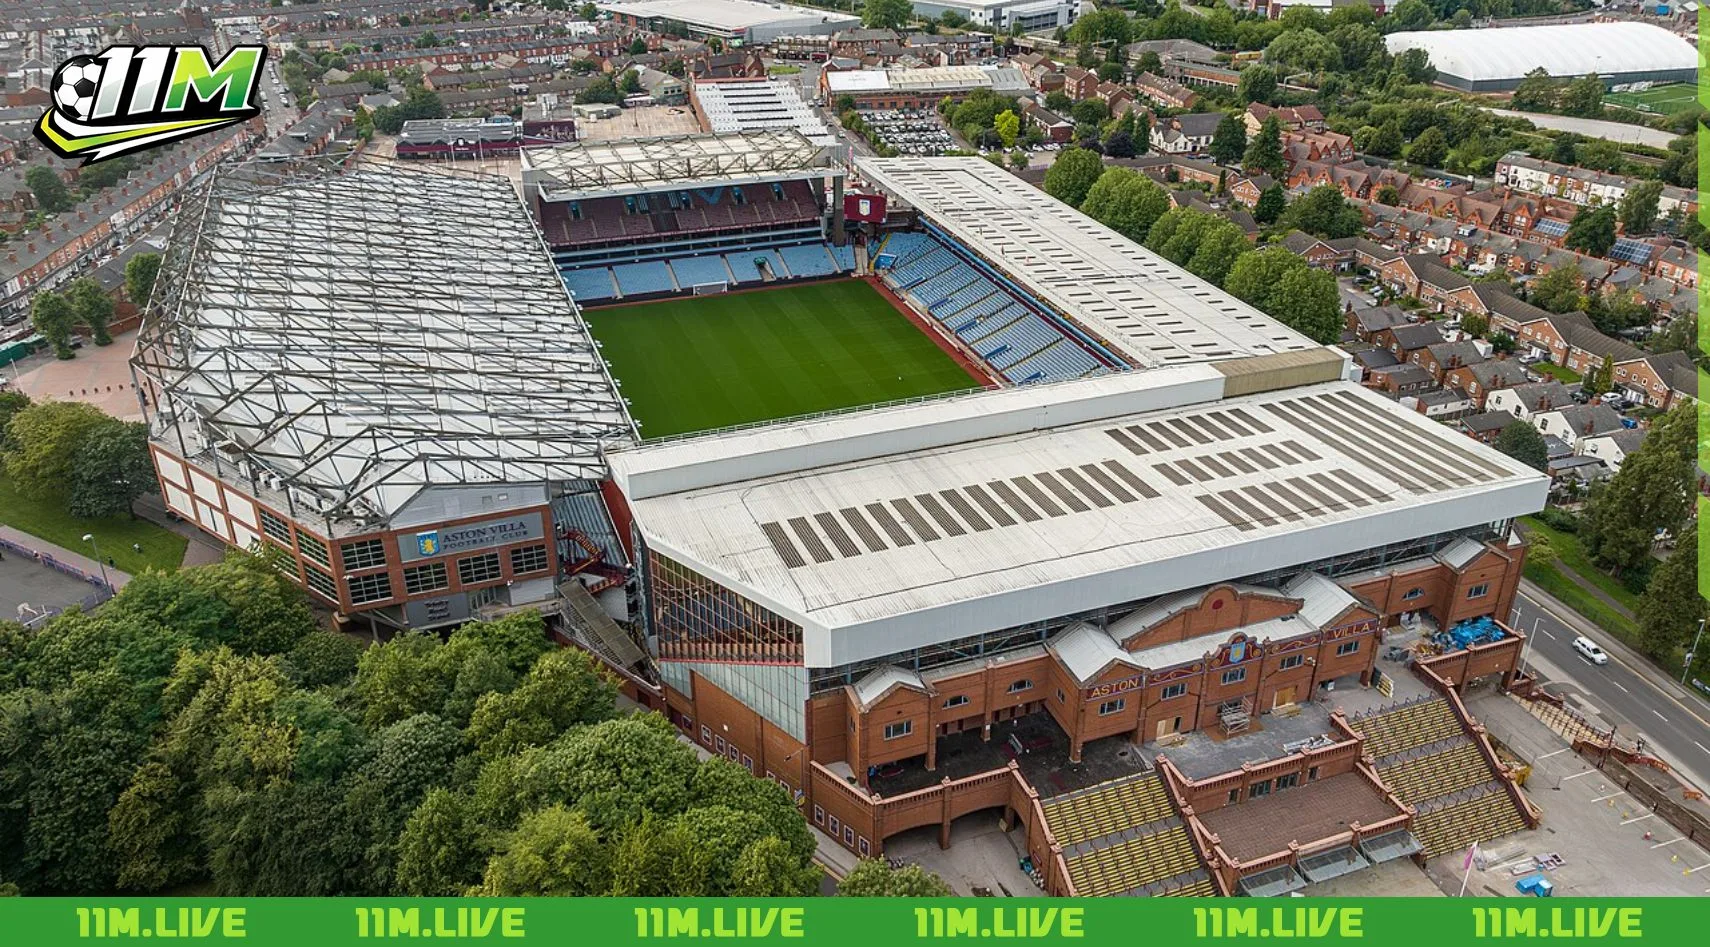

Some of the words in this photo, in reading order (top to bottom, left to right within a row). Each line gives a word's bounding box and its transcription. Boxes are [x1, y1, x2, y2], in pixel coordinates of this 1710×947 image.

[443, 528, 488, 542] ASTON
[488, 521, 526, 533] VILLA
[443, 537, 496, 549] FOOTBALL
[501, 531, 529, 540] CLUB
[1091, 678, 1139, 698] ASTON
[1333, 622, 1371, 639] VILLA
